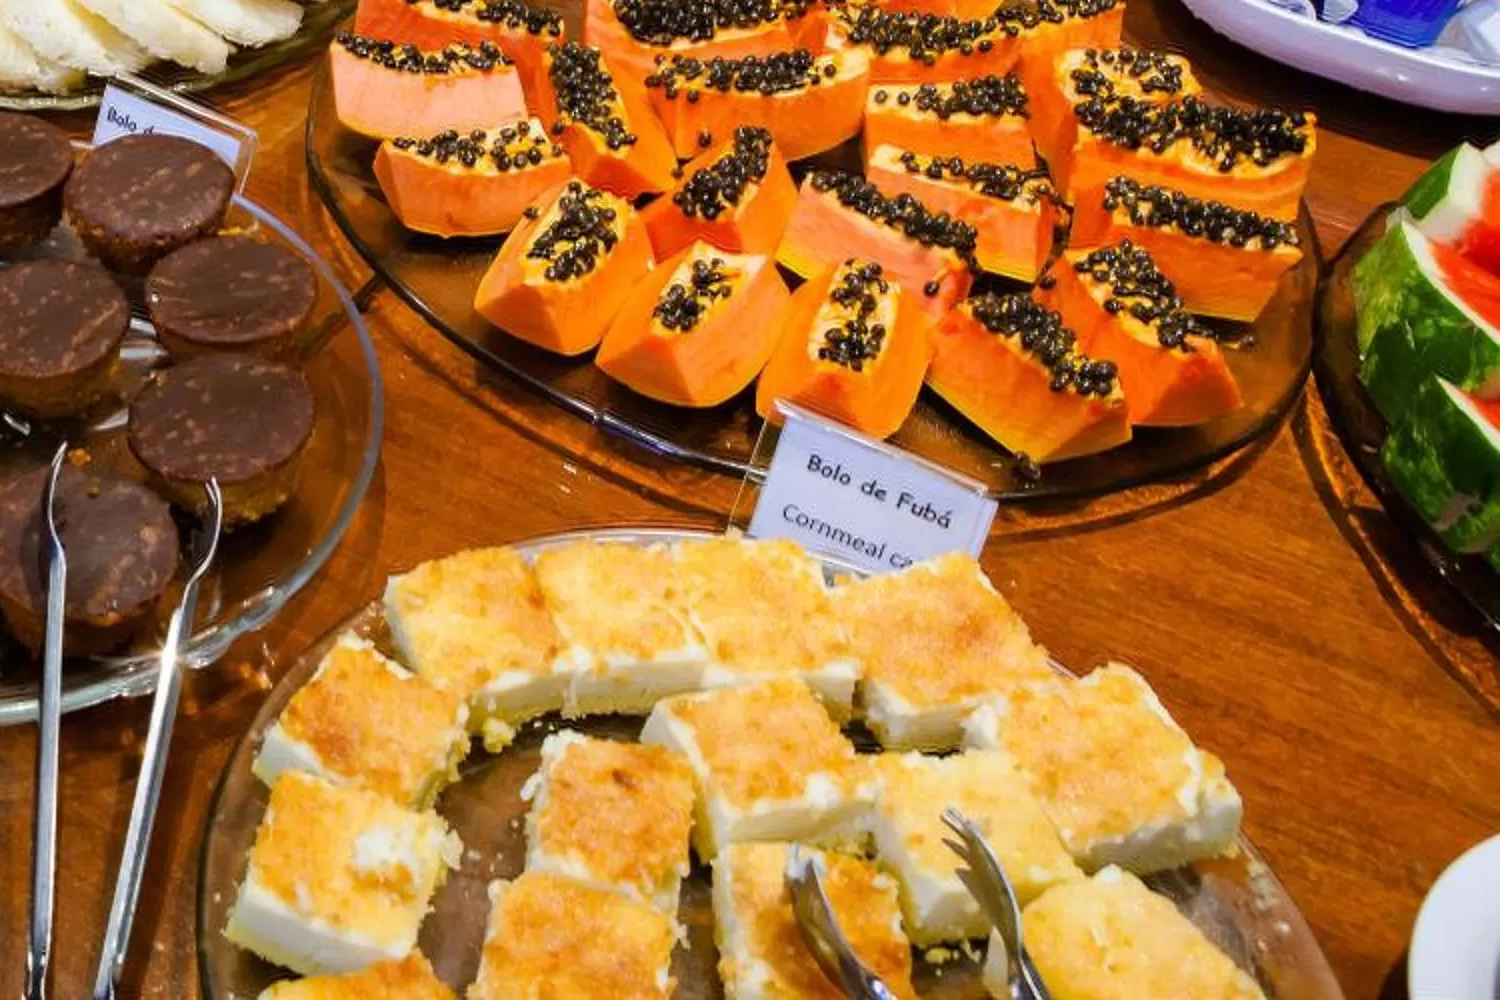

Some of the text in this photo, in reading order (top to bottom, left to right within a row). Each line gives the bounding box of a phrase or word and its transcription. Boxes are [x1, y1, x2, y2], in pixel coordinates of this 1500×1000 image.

[106, 107, 137, 133] Bolo
[806, 454, 954, 530] Bolo de Fubá
[782, 504, 914, 570] Cornmeal ca
